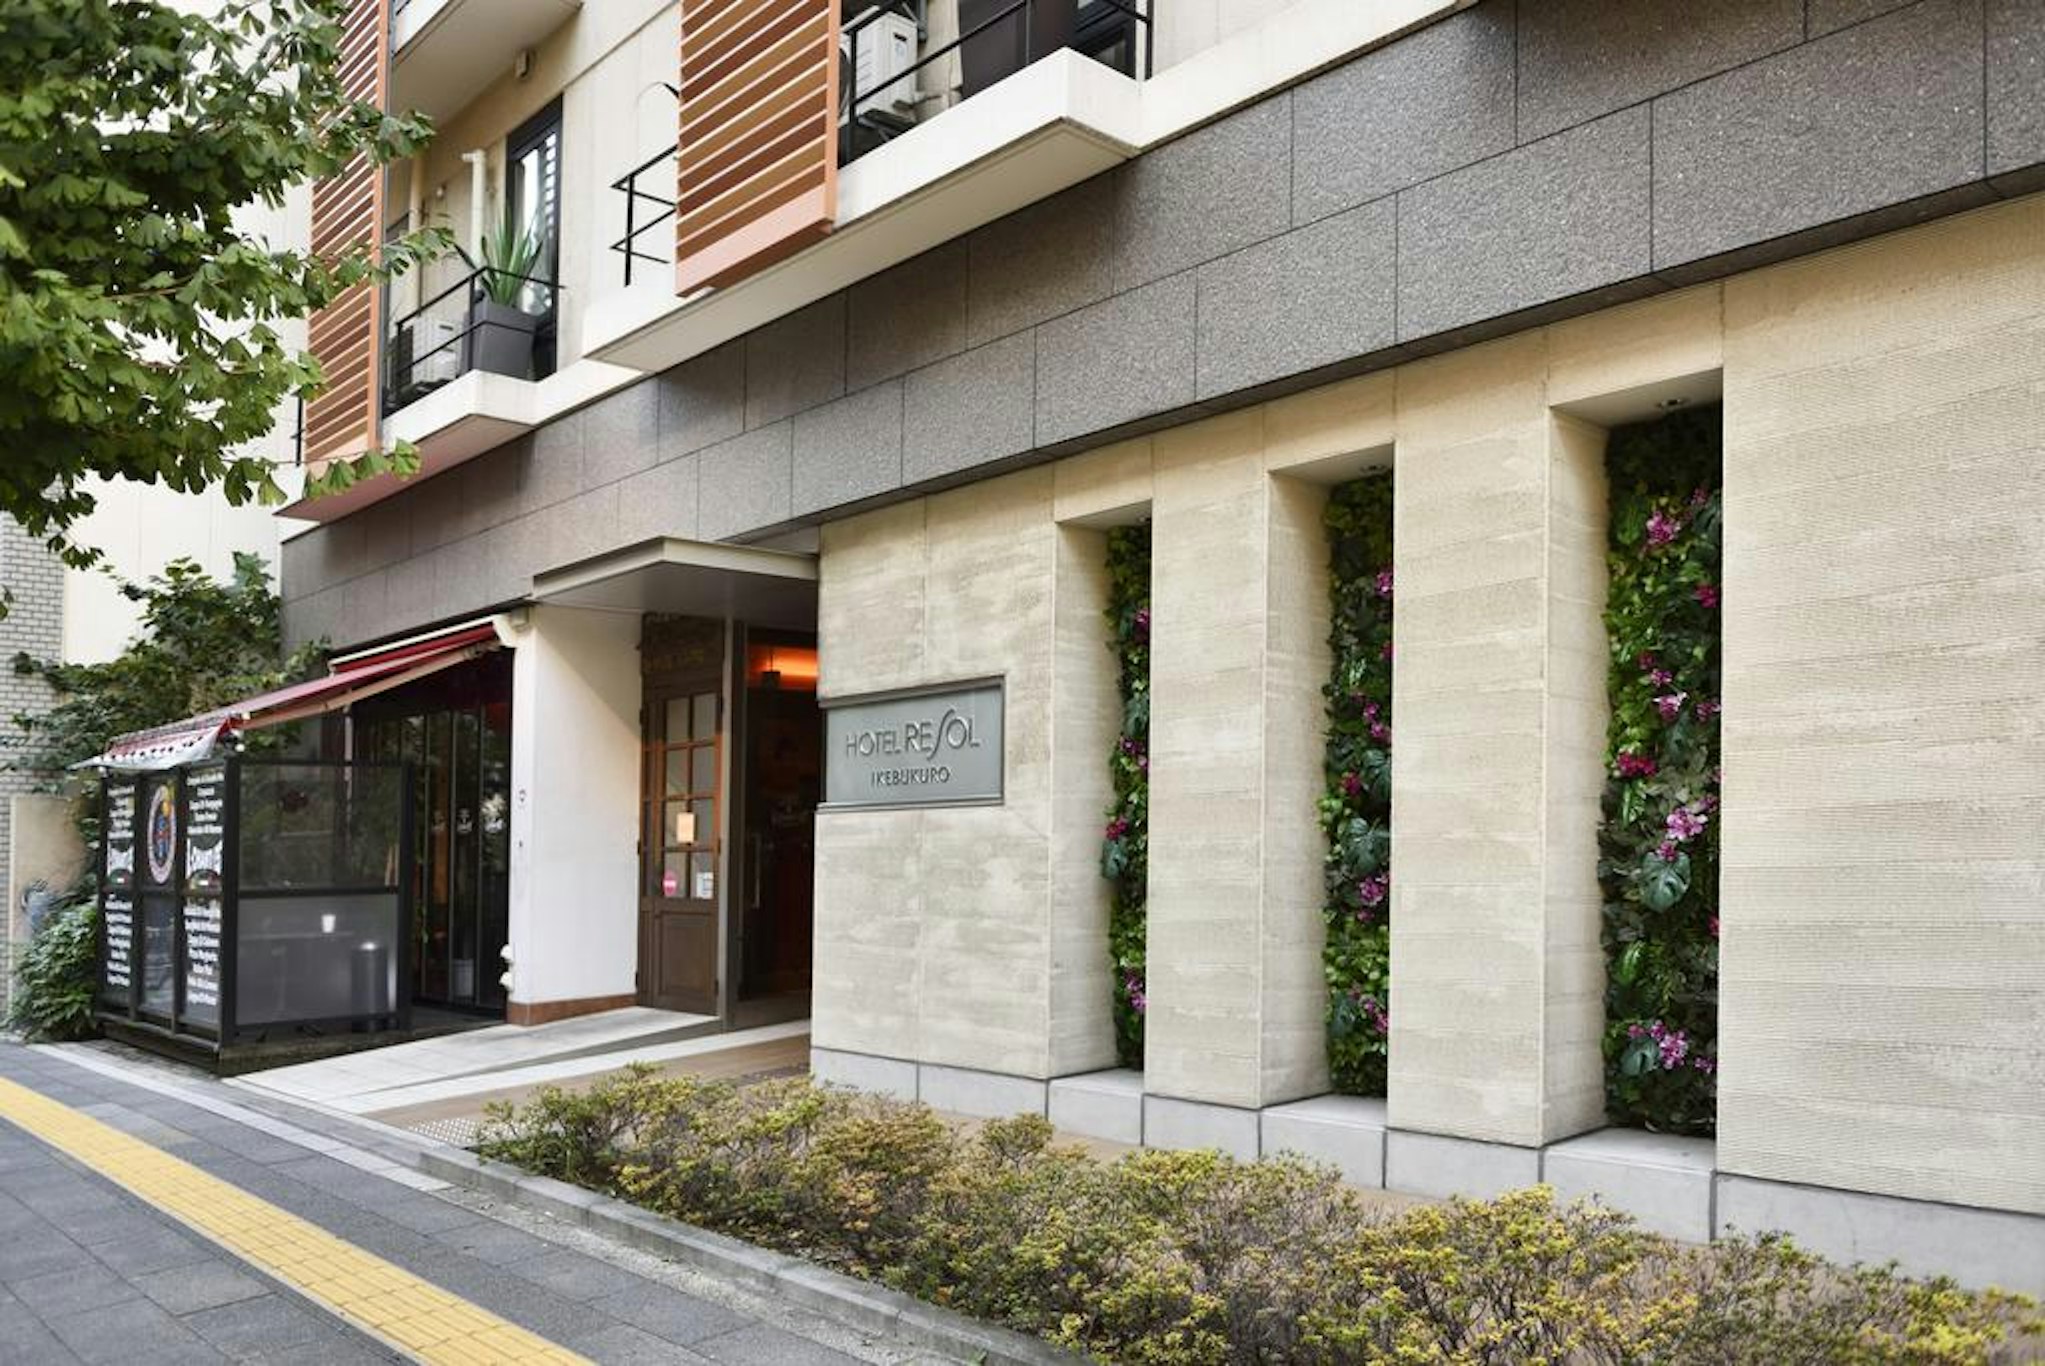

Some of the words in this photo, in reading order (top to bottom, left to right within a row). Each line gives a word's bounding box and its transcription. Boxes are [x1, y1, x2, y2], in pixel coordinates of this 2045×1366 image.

[846, 730, 900, 757] HOTEL
[904, 708, 981, 761] RESOL
[871, 766, 951, 788] IKEBUKURO
